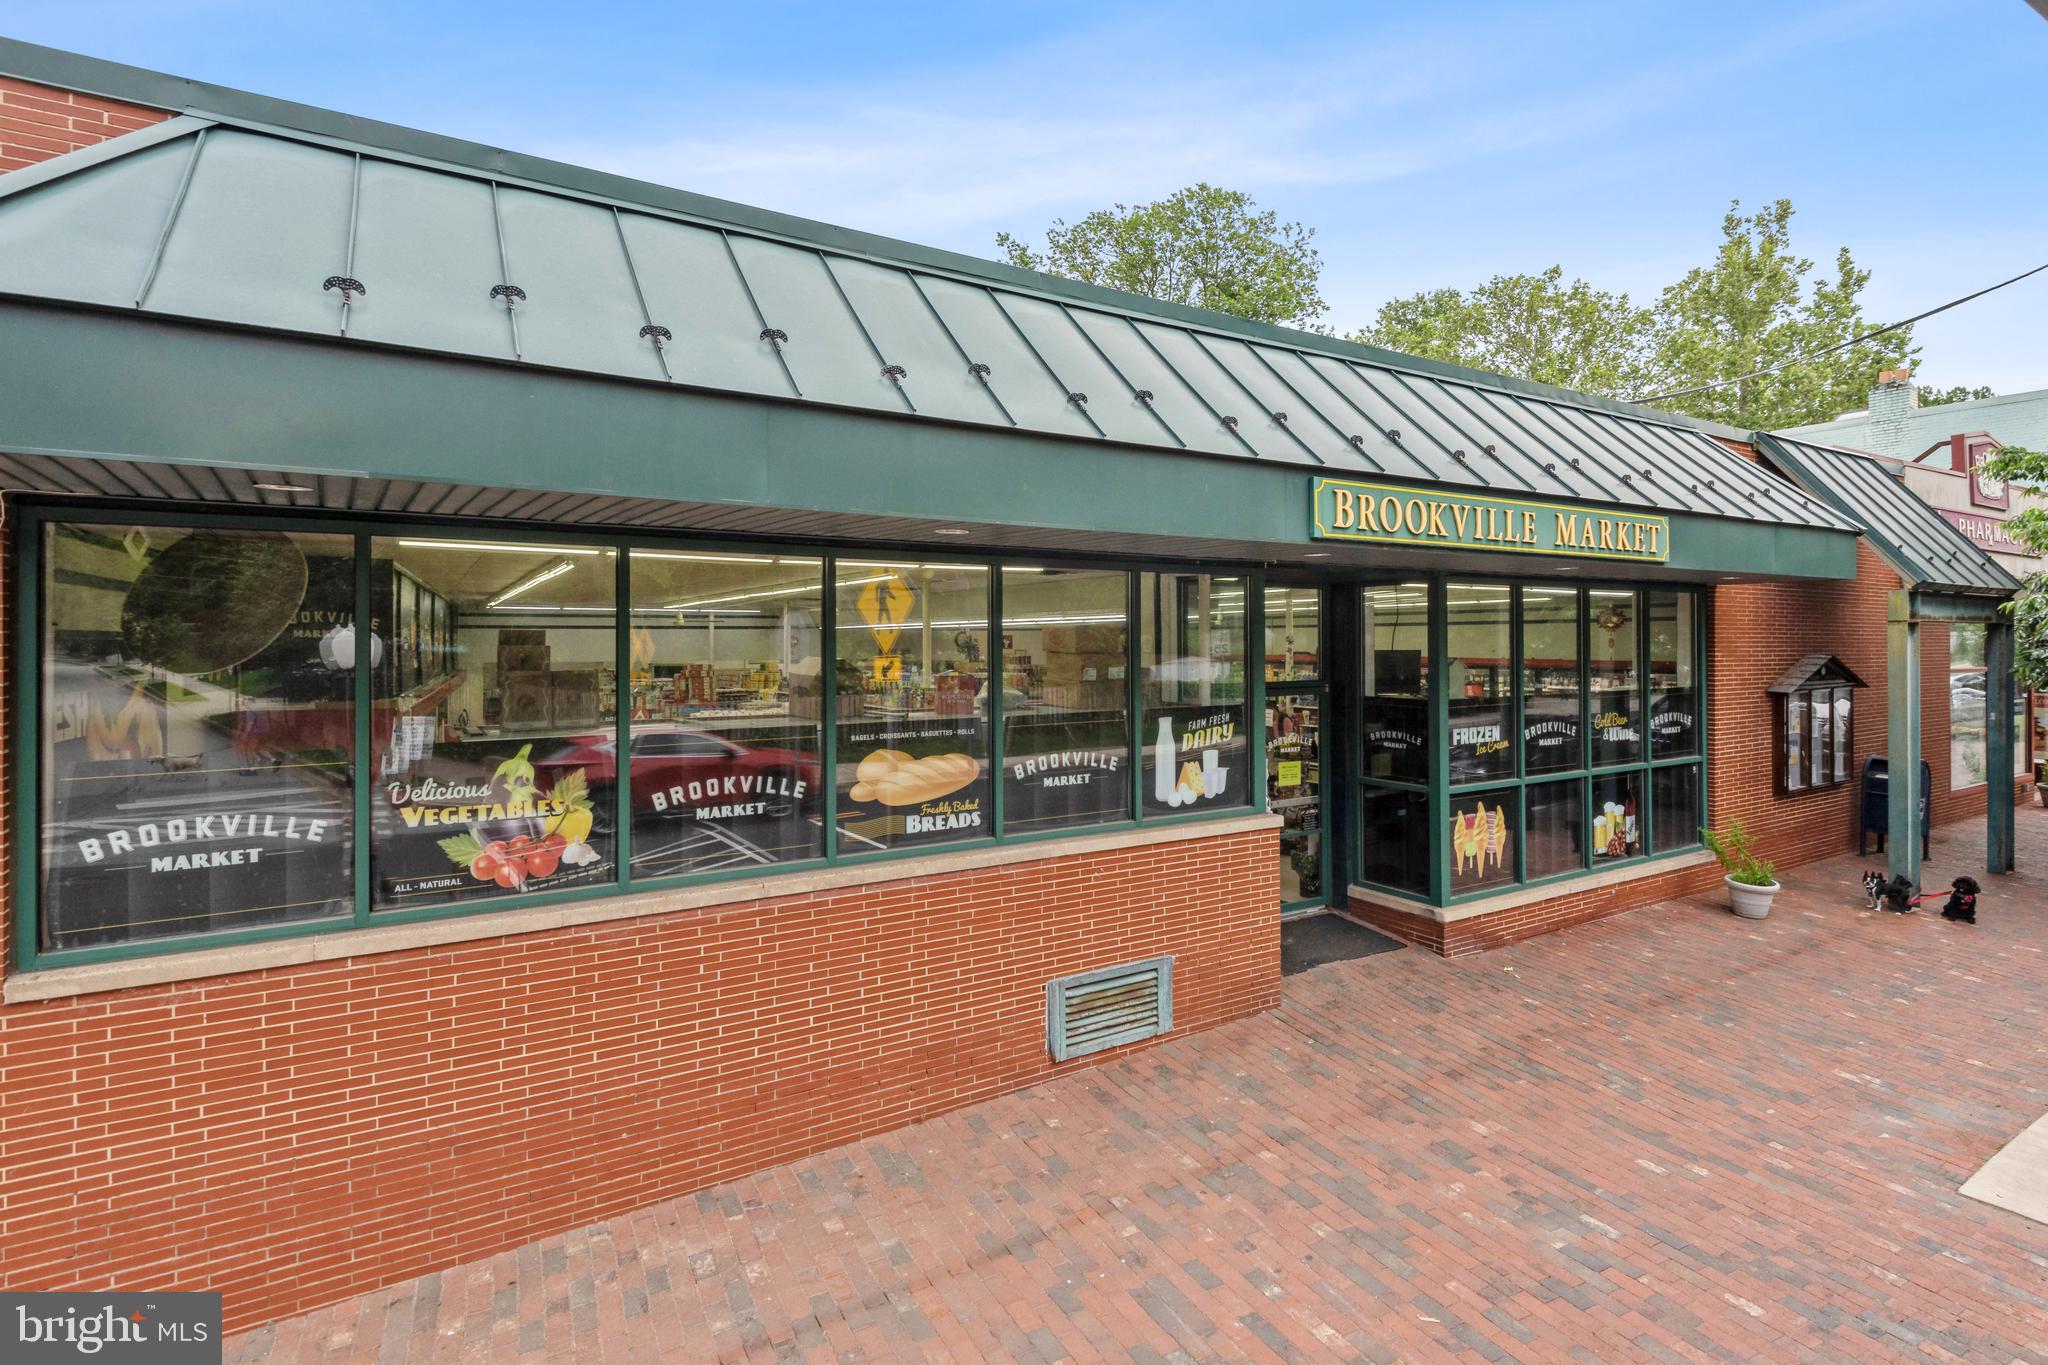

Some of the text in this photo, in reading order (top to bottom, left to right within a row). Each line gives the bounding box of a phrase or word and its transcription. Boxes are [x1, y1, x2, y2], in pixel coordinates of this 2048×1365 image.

[1333, 488, 1661, 553] BROOKVILLE MARKET
[1958, 518, 2024, 546] PHARMAC
[1188, 712, 1230, 732] FARM FRESH
[1525, 721, 1577, 740] BROOKVILLE
[1650, 712, 1692, 729] BROOKVILLE
[1661, 726, 1681, 734] MARKET
[879, 731, 917, 740] CROISSANTS
[920, 729, 953, 737] BAGUETTES
[1181, 722, 1235, 752] DAIRY
[1370, 730, 1422, 746] BROOKVILLE
[1452, 725, 1501, 746] FROZEN
[1538, 737, 1563, 746] MARKET
[1475, 742, 1486, 756] Ice
[1013, 751, 1119, 780] BROOKVILLE
[388, 777, 492, 804] Delicious
[1043, 773, 1091, 788] MARKET
[651, 775, 807, 812] BROOKVILLE
[400, 800, 566, 828] VEGETABLES
[696, 802, 766, 820] MARKET
[920, 798, 979, 817] Freshly Baked
[906, 811, 982, 834] BREADS
[78, 815, 328, 864] BROOKVILLE
[151, 847, 263, 873] MARKET
[394, 884, 413, 893] ALL
[419, 878, 463, 890] NATURAL
